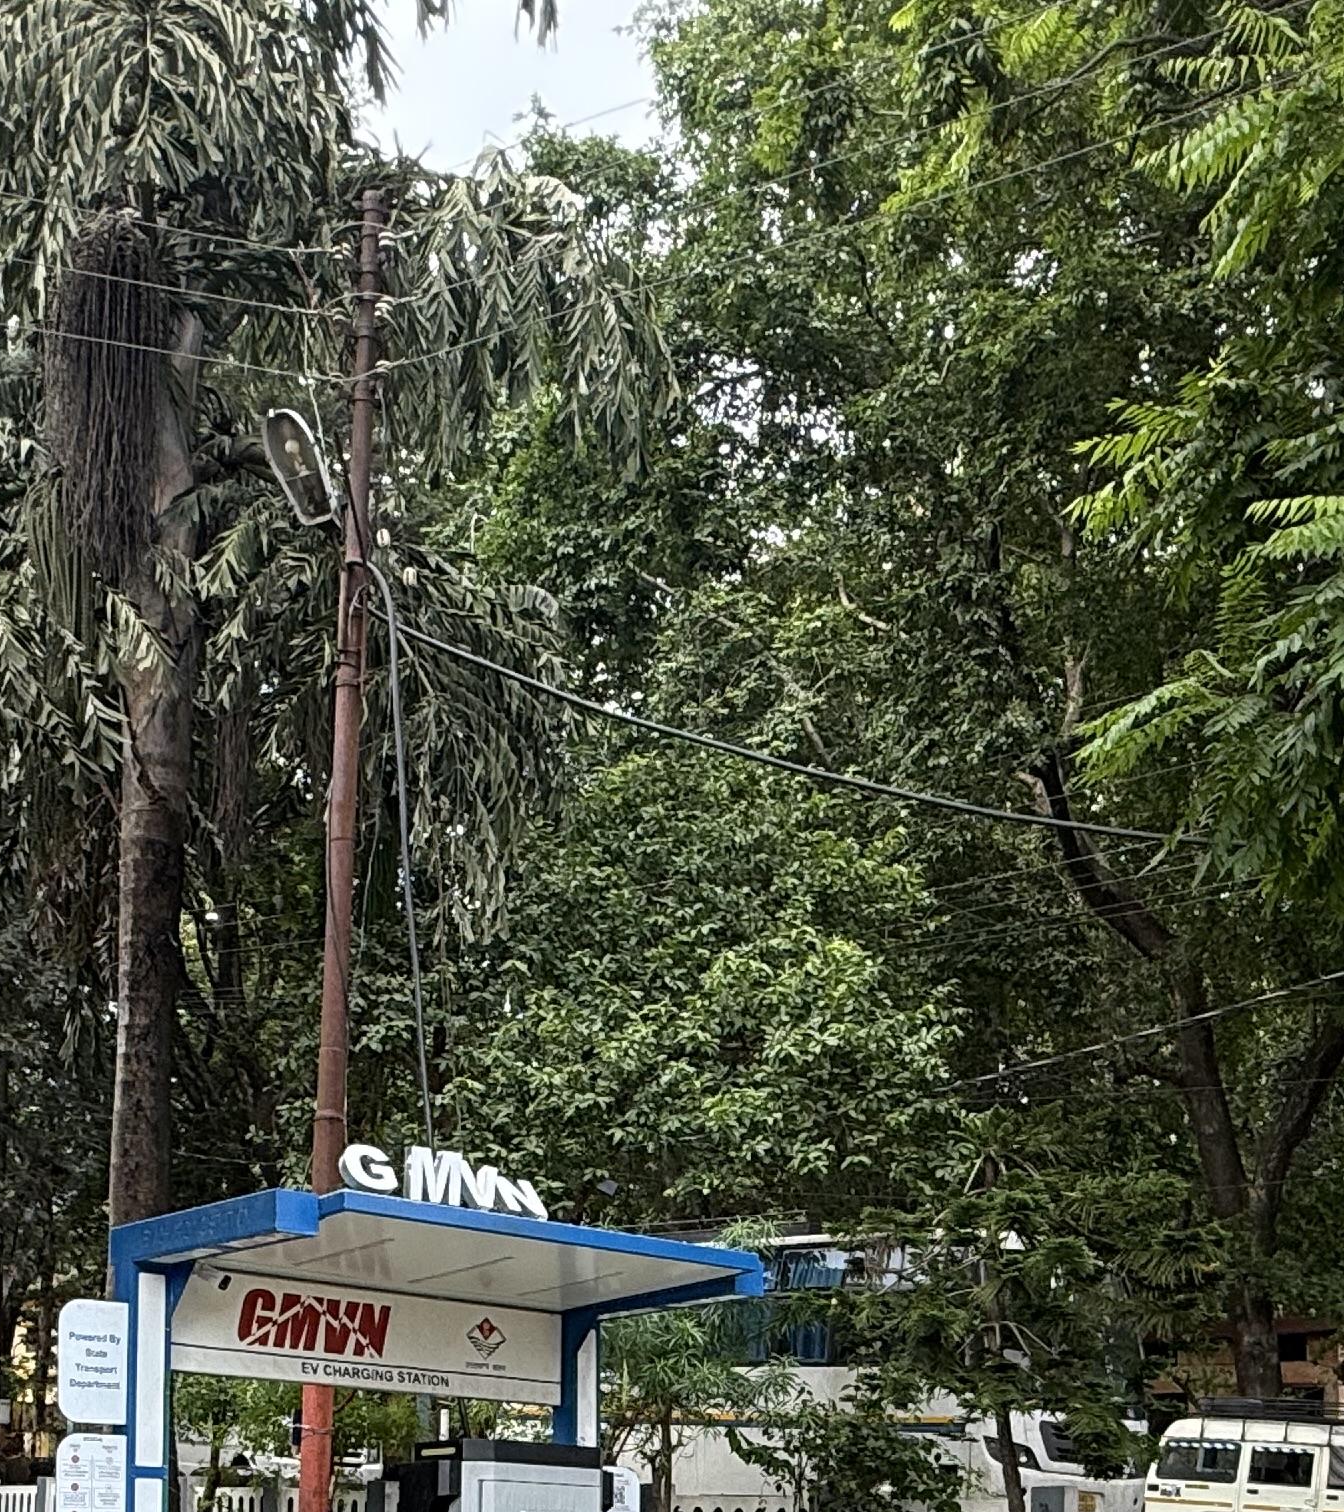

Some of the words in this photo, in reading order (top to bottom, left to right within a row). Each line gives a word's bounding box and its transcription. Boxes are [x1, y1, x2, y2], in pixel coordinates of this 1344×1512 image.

[339, 1144, 548, 1221] GMVN
[238, 1289, 391, 1358] GMVN
[69, 1331, 107, 1342] Powered
[109, 1334, 121, 1346] By
[75, 1362, 118, 1375] Transport
[301, 1362, 320, 1375] EV
[323, 1364, 394, 1384] CHARGING
[397, 1370, 450, 1387] STATION
[69, 1378, 121, 1390] Department
